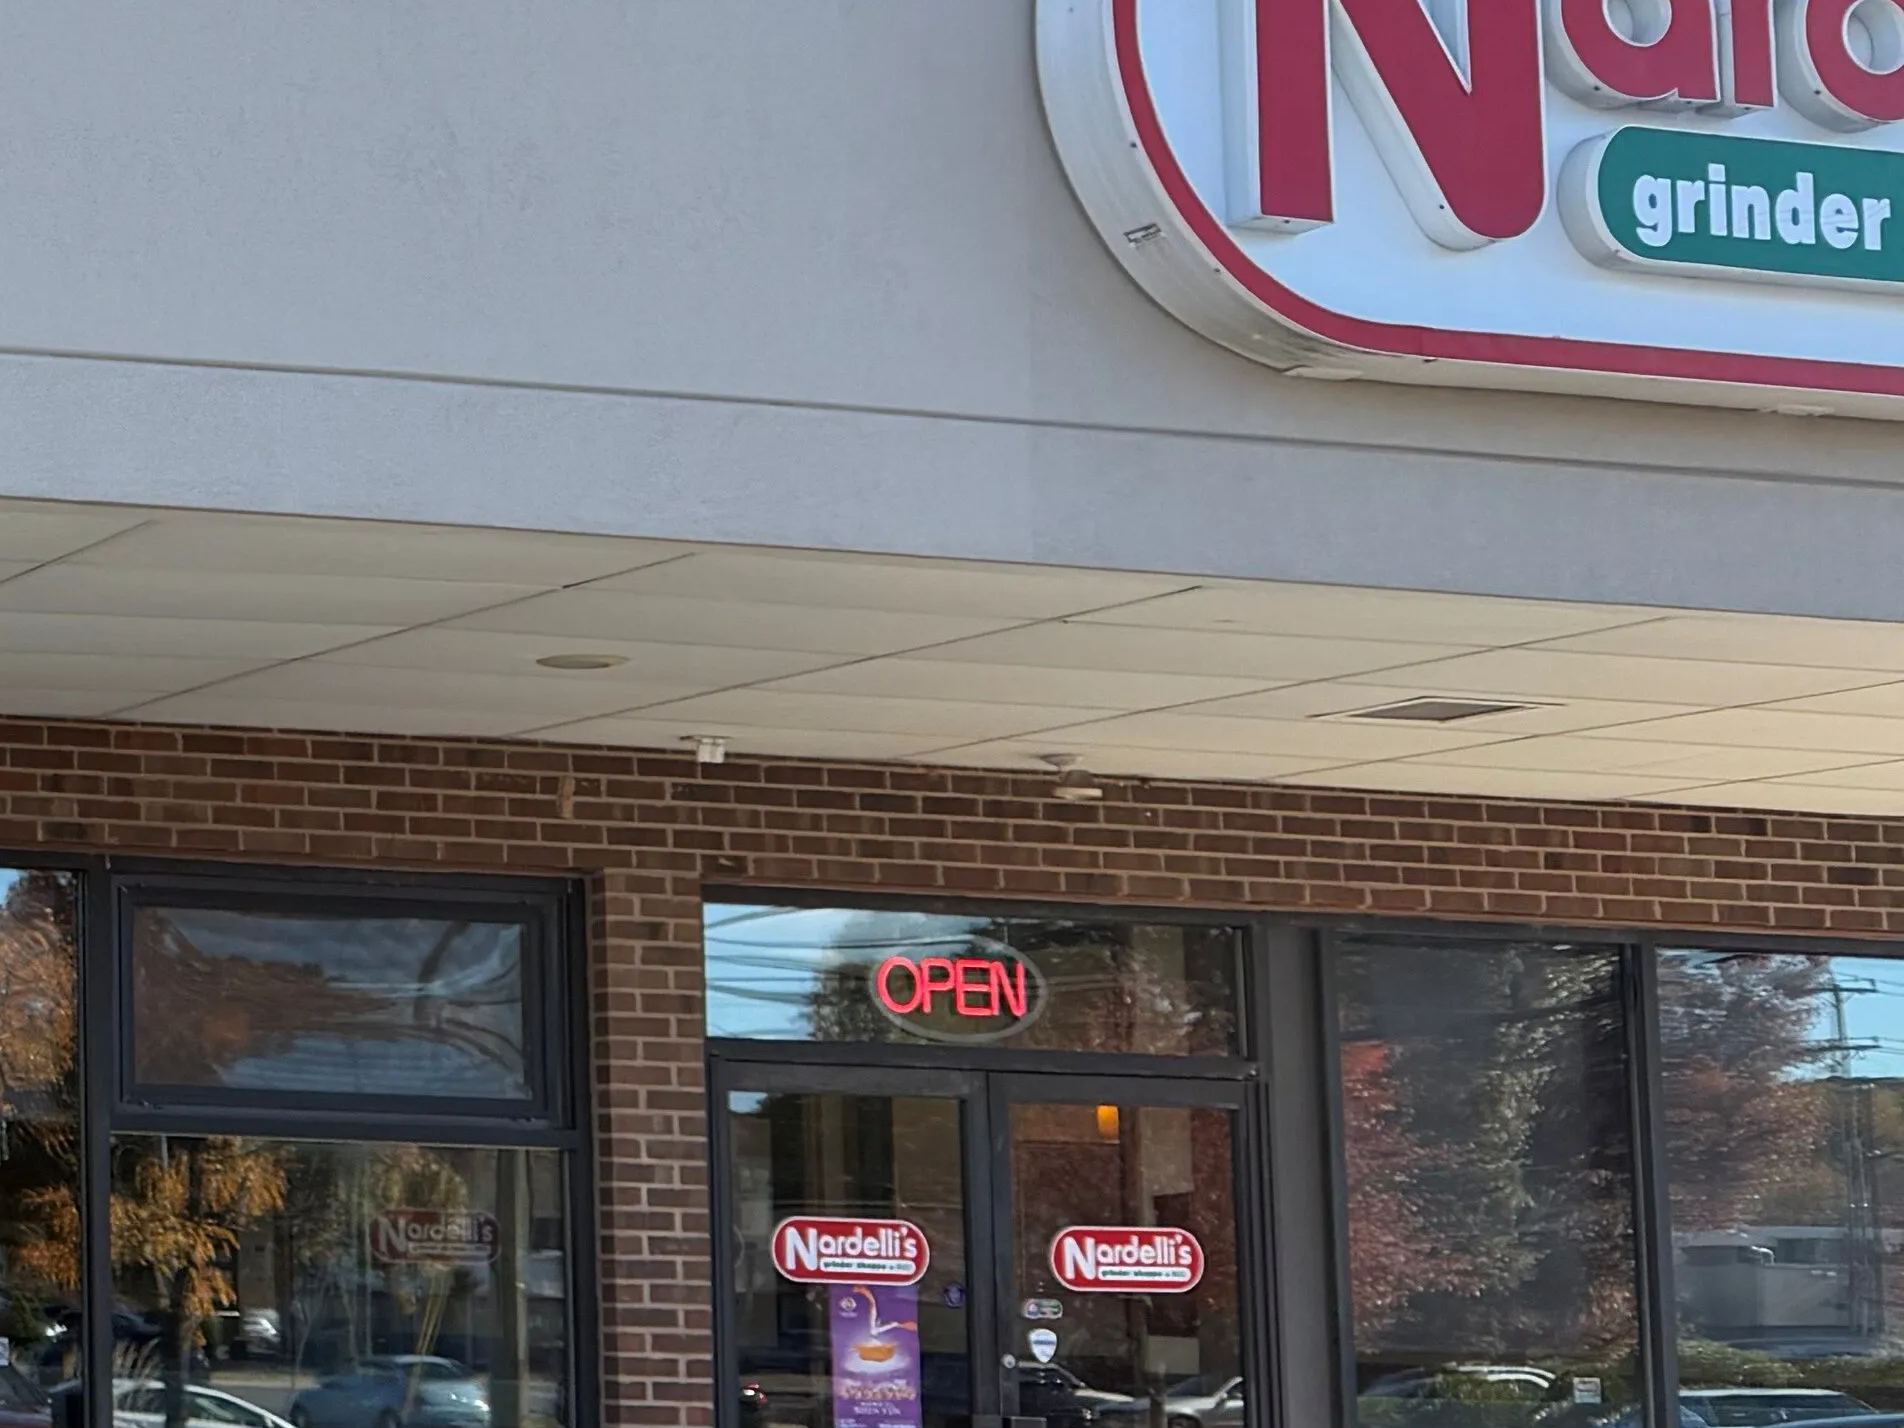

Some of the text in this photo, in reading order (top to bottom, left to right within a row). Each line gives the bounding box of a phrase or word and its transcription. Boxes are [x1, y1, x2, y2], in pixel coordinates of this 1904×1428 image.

[1632, 162, 1891, 251] grinder
[876, 955, 1026, 1018] OPEN
[783, 1225, 918, 1271] Nardelli's
[1063, 1234, 1193, 1280] Nardelli's
